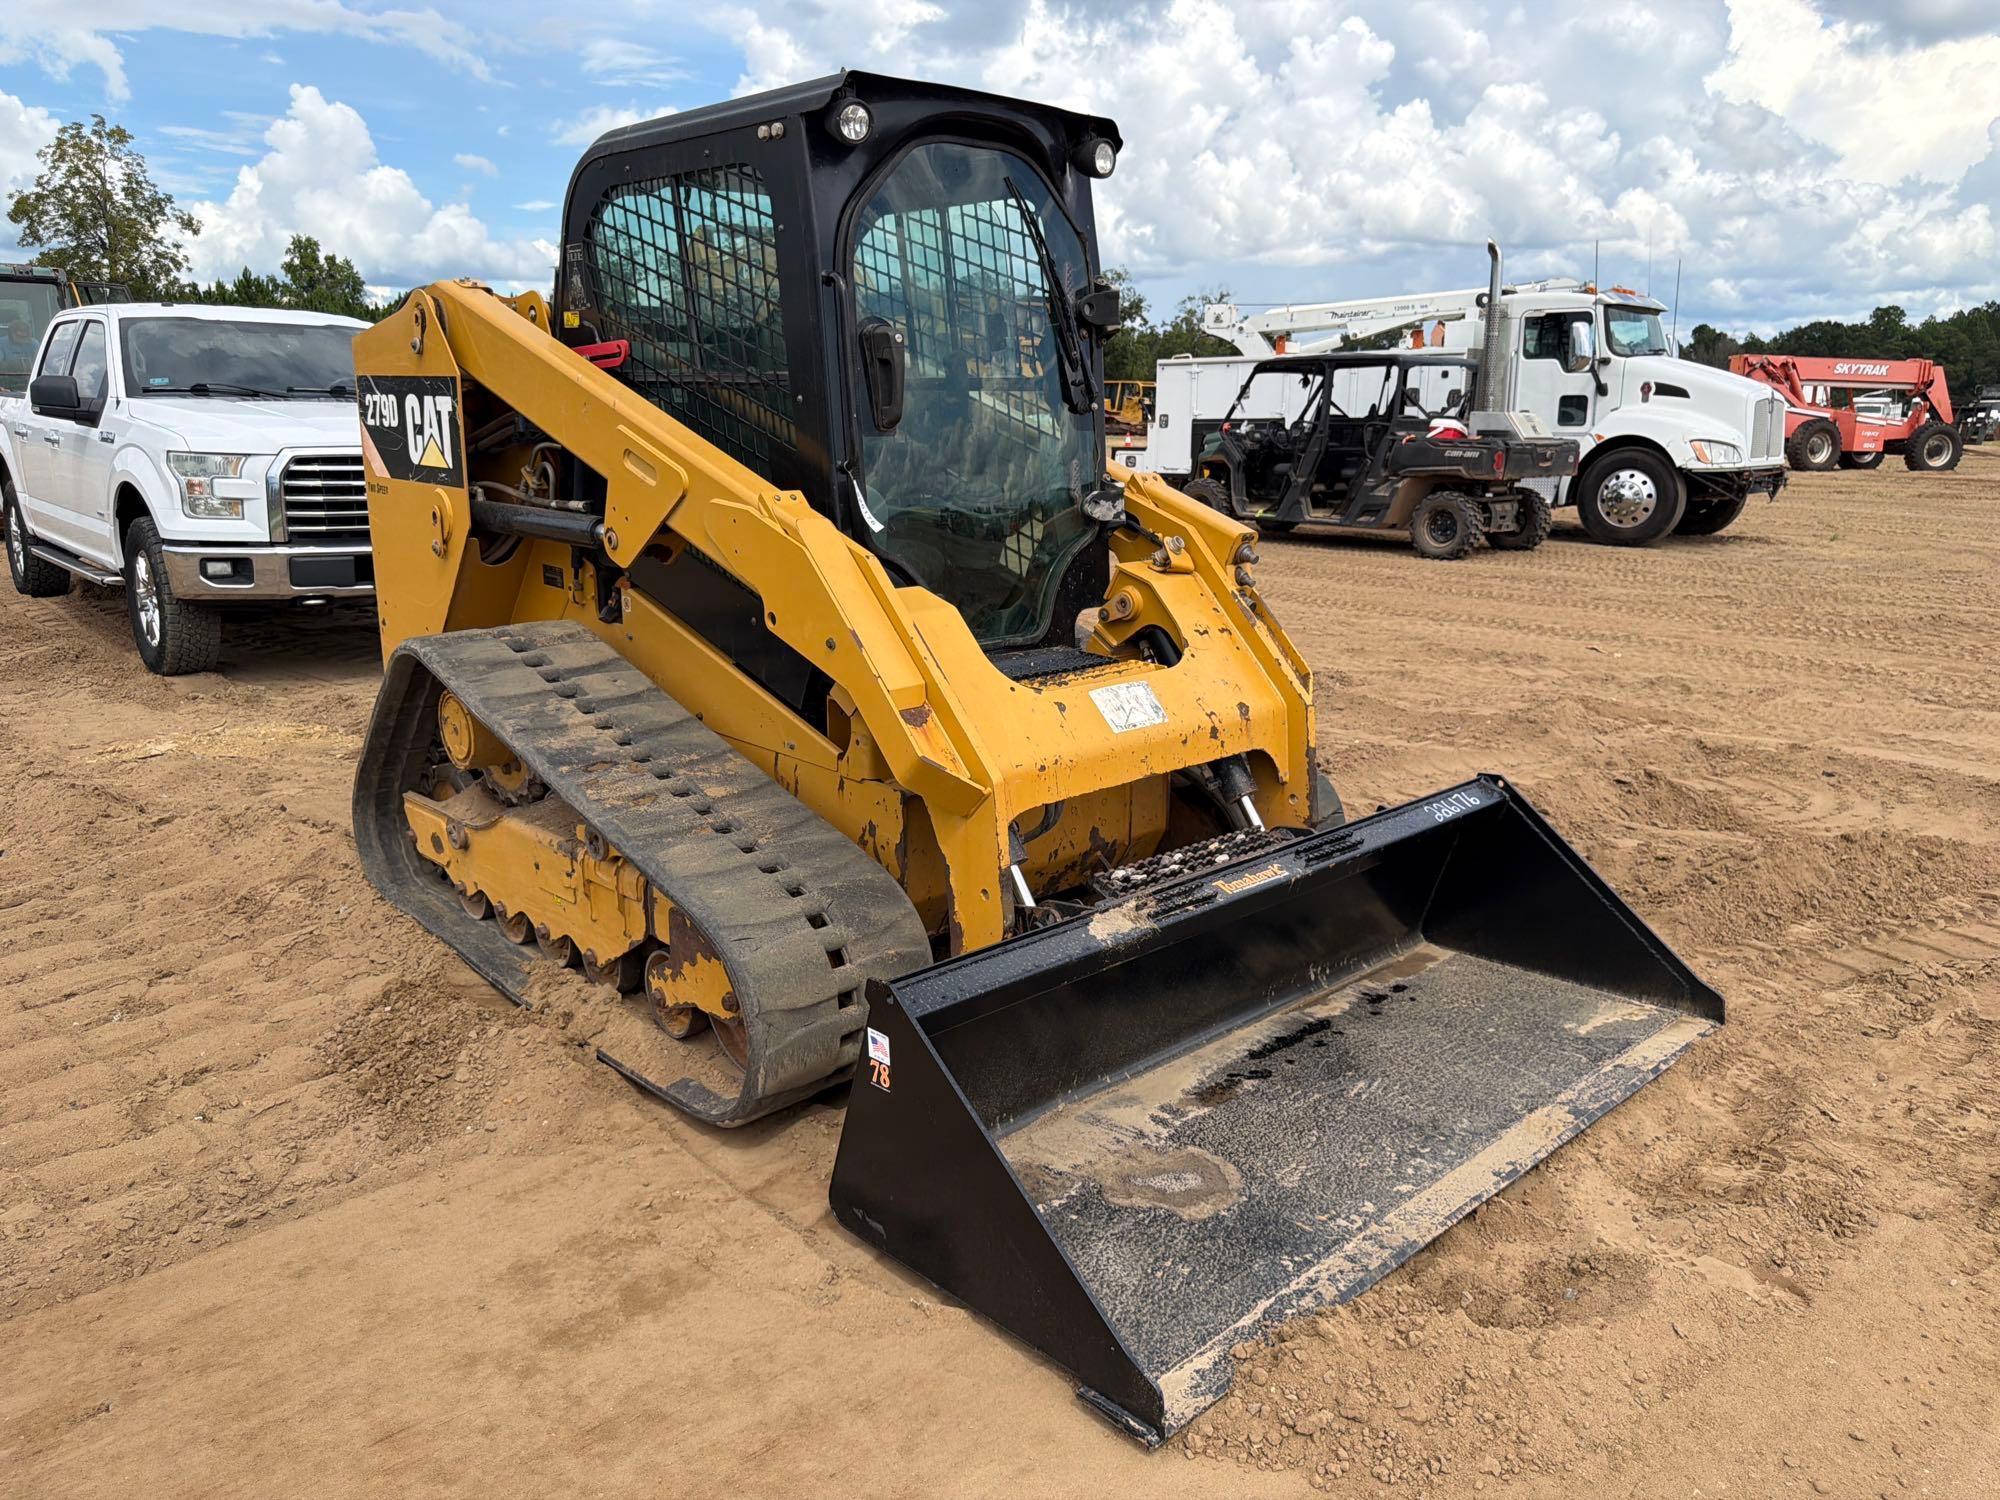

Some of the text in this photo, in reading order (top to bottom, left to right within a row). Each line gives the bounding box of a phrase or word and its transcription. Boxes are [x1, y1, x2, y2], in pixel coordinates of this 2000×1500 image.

[1834, 363, 1890, 376] SKYTRAK
[365, 393, 399, 428] 279D
[405, 393, 454, 470] CAT
[1423, 791, 1481, 822] 226176
[1211, 863, 1290, 895] Tomahawk
[869, 1059, 891, 1089] 78
